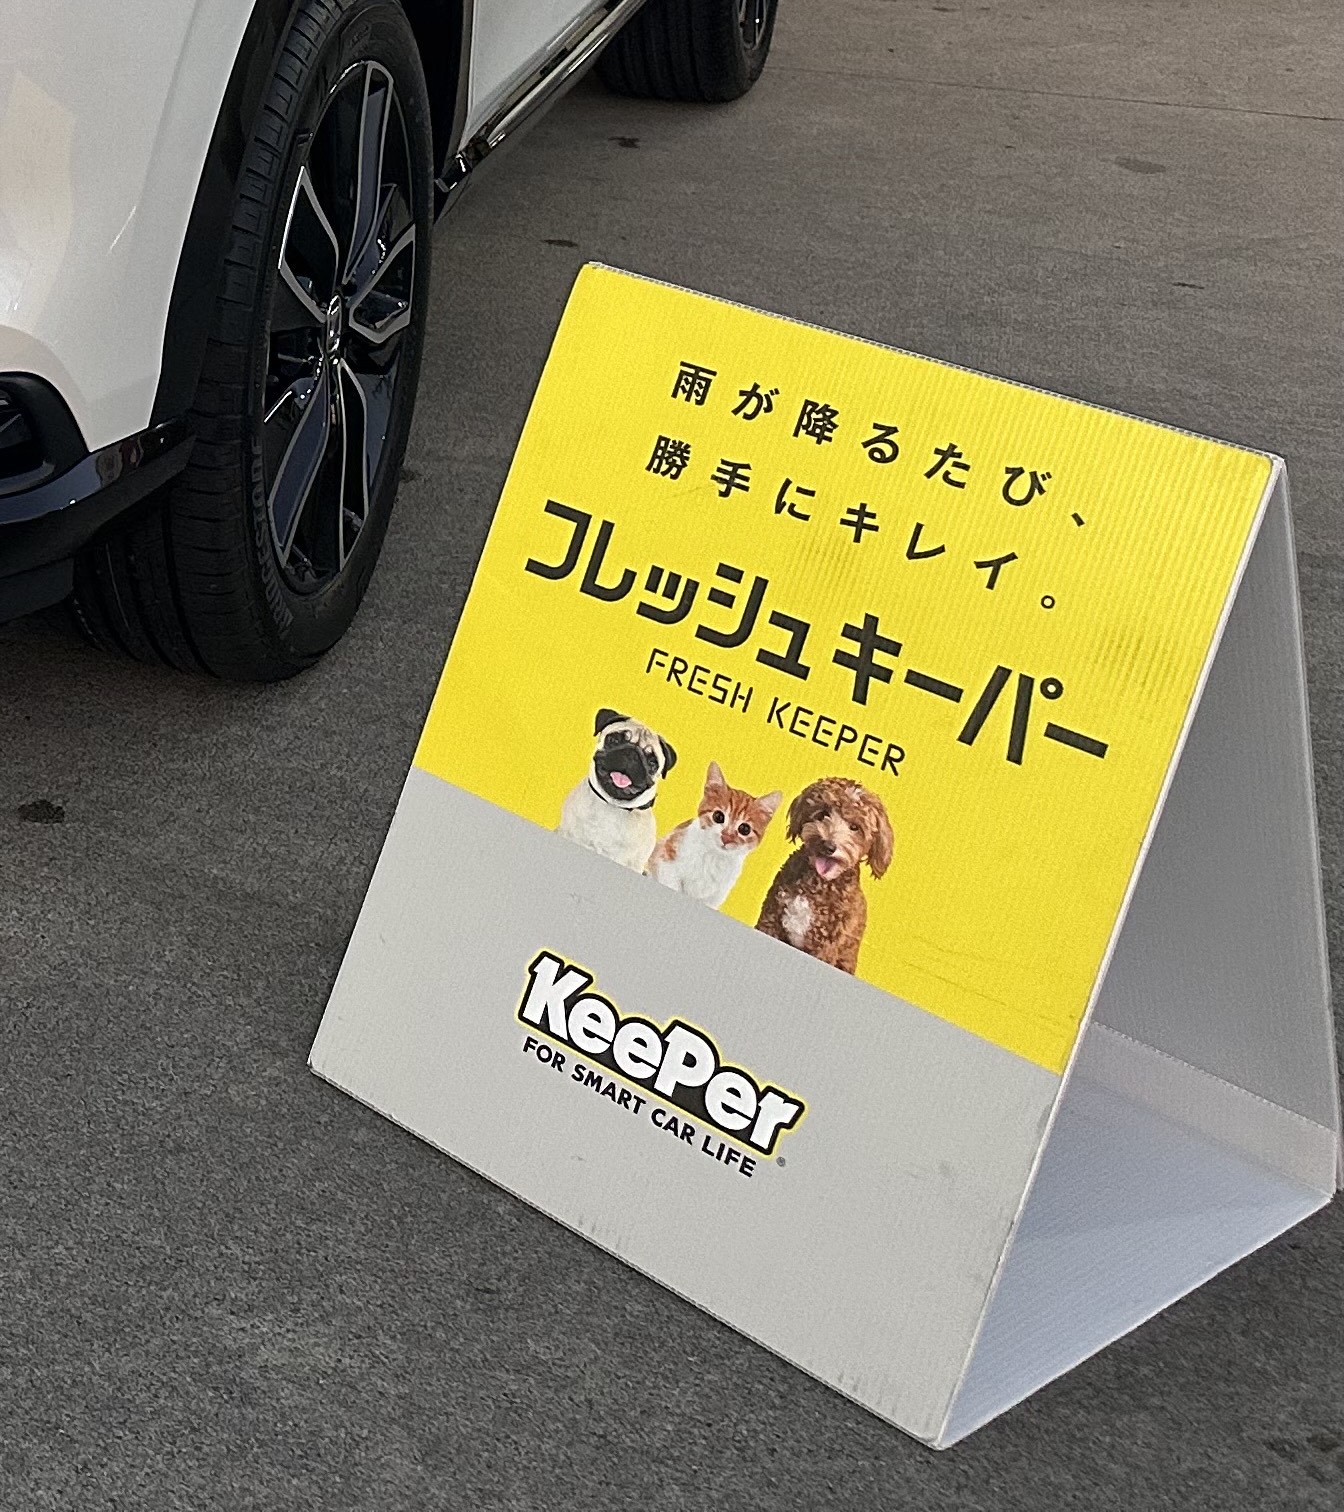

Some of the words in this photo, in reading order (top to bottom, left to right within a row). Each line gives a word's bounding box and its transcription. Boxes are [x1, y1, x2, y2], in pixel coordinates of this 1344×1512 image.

[645, 434, 1055, 609] 勝手にキレイ。
[671, 361, 1085, 527] 雨が降るたび、
[525, 499, 1109, 765] フレッシュキーパー
[645, 648, 754, 712] FRESH
[766, 697, 907, 776] KEEPER
[518, 950, 805, 1155] KeePer
[522, 1036, 566, 1072] FOR
[571, 1064, 647, 1115] SMART
[650, 1108, 696, 1145] CAR
[701, 1134, 757, 1178] LIFE
